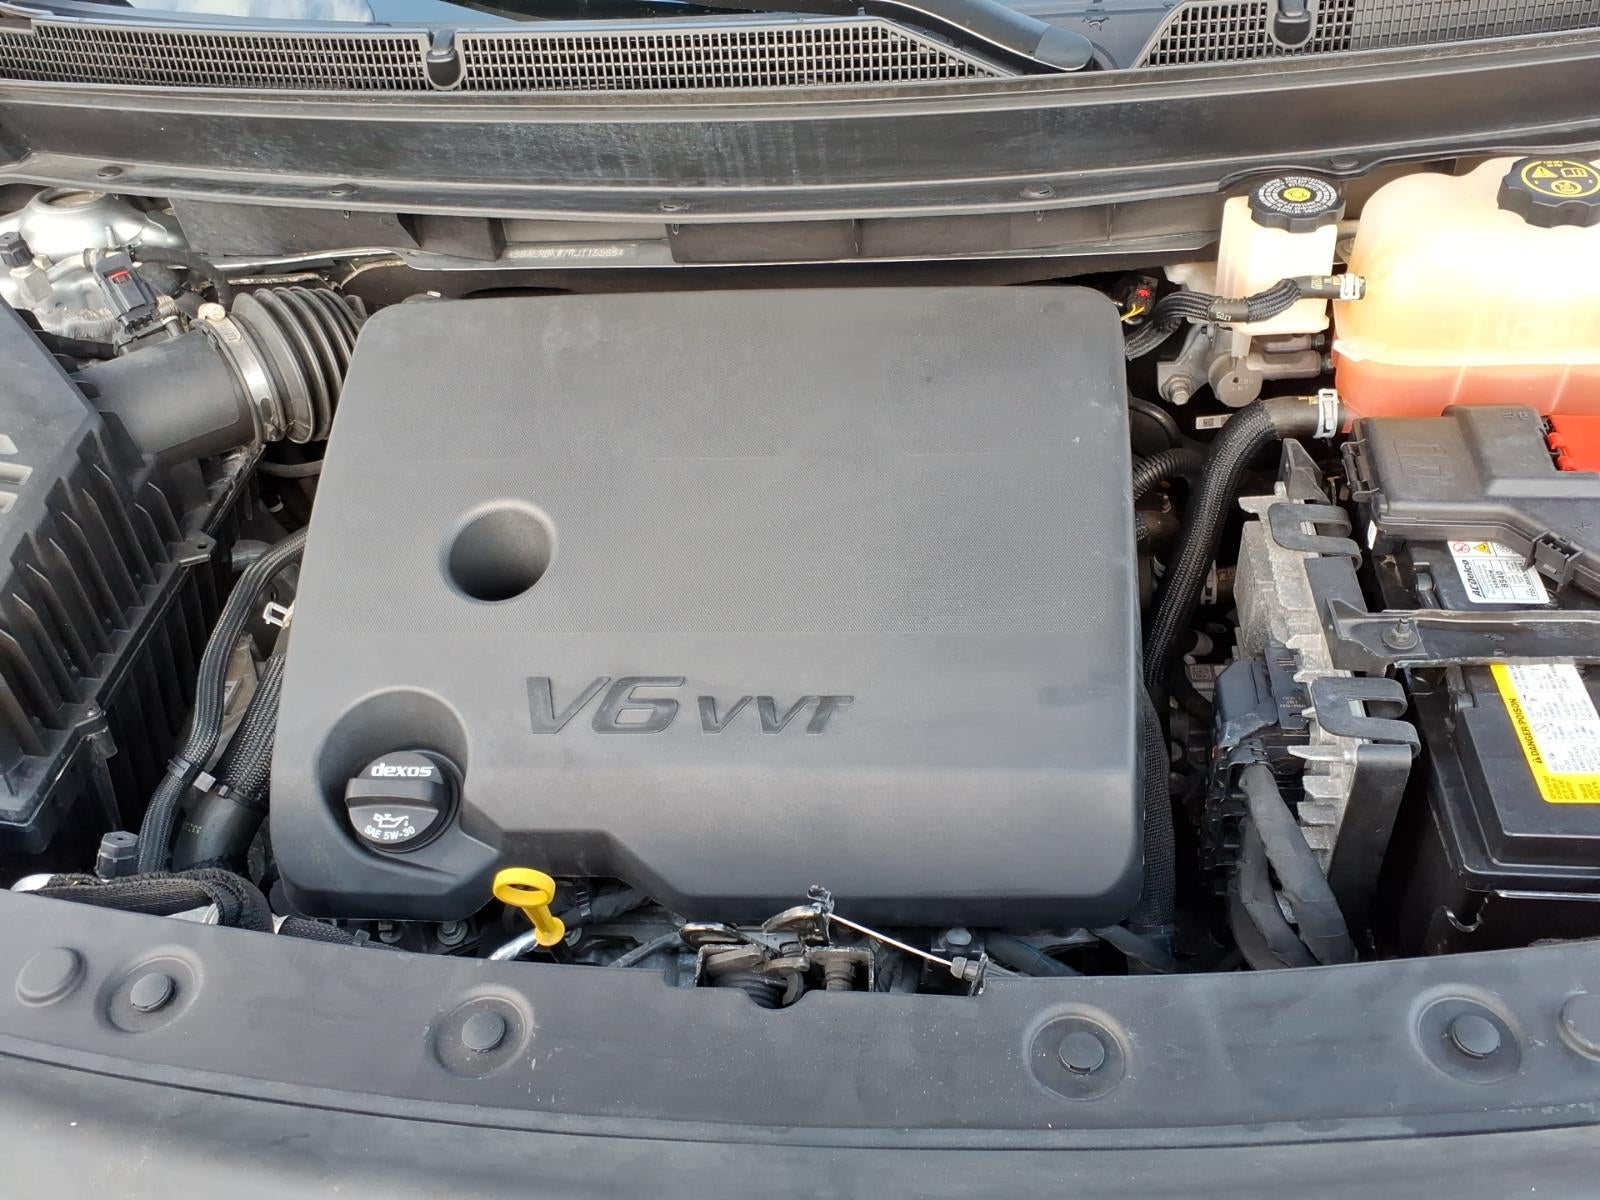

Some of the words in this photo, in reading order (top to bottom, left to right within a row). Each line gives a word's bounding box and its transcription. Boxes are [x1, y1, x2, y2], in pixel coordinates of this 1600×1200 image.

[1462, 559, 1482, 598] ACDelco
[525, 676, 687, 735] V6
[697, 695, 855, 735] VVT
[371, 762, 434, 777] dexos
[363, 824, 382, 839] SAE
[383, 826, 416, 841] 5W-30
